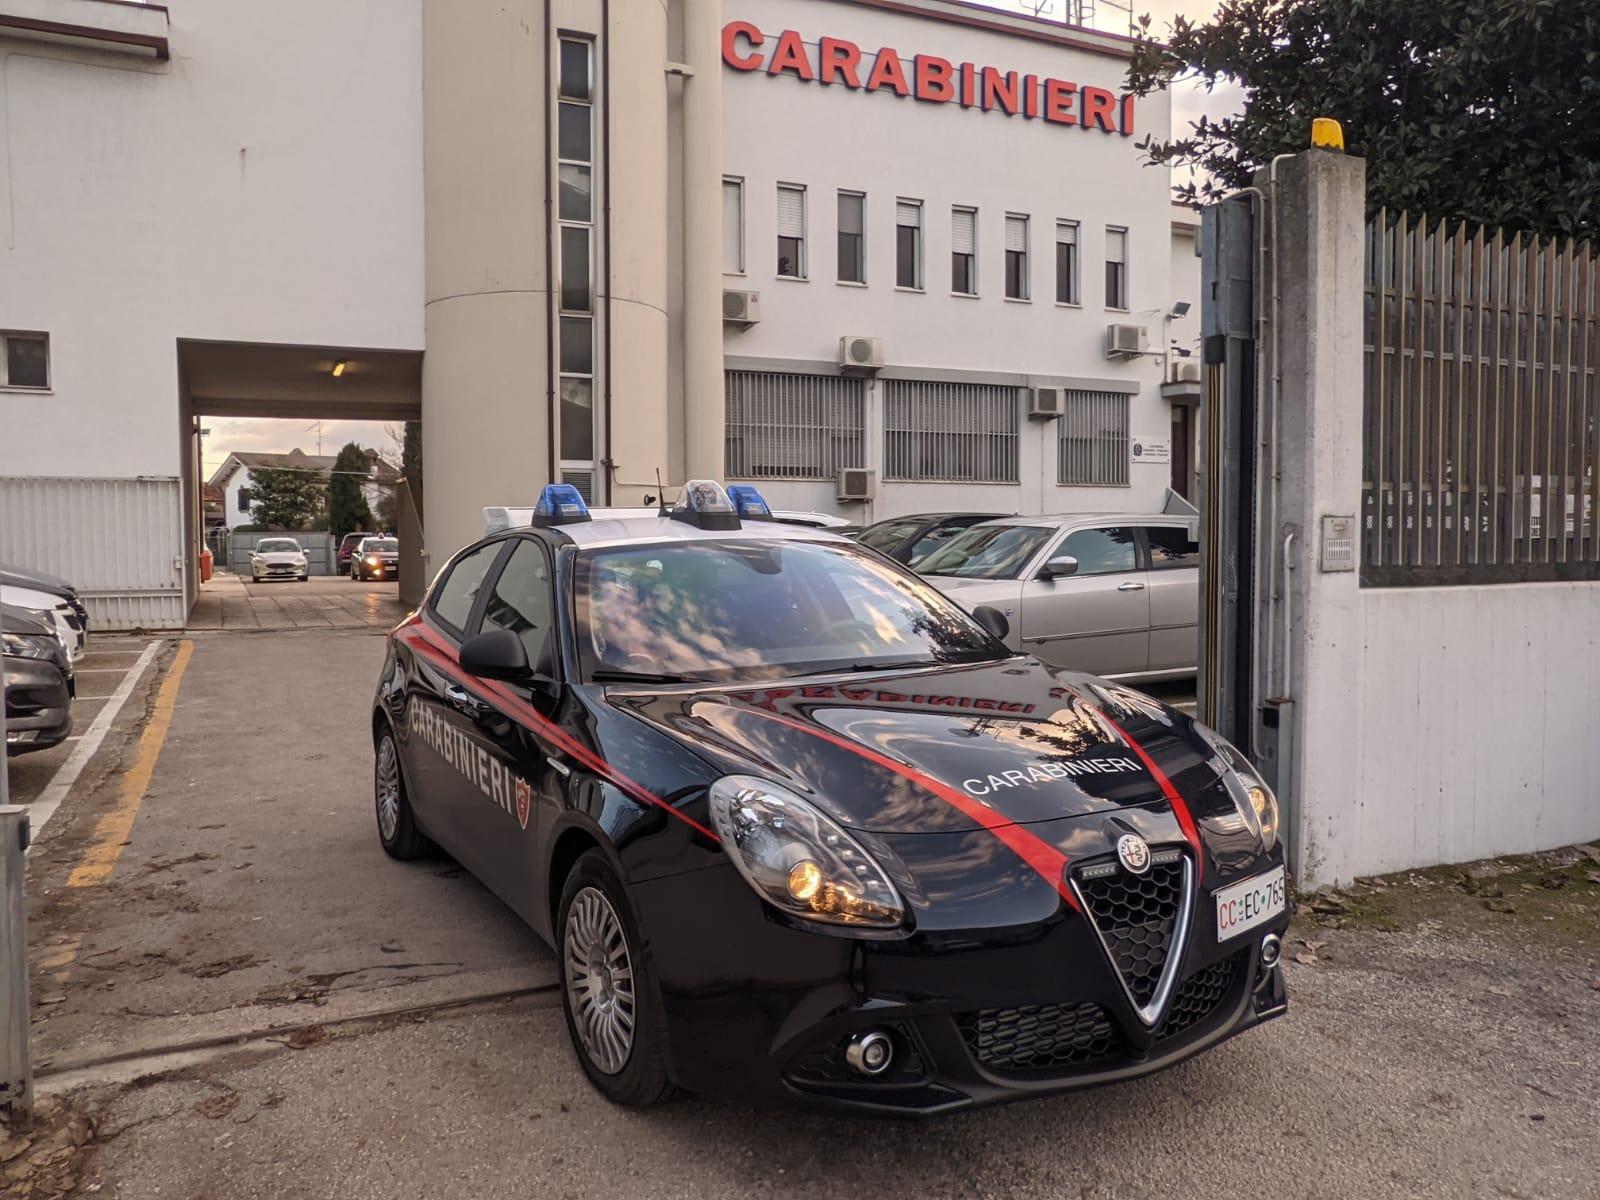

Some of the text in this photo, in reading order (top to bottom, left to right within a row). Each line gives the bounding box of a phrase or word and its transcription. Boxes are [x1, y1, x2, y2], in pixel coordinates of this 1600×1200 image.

[721, 21, 1135, 136] CARABINIERI
[410, 694, 512, 815] CARABINIERI
[962, 757, 1143, 796] CARABINIERI
